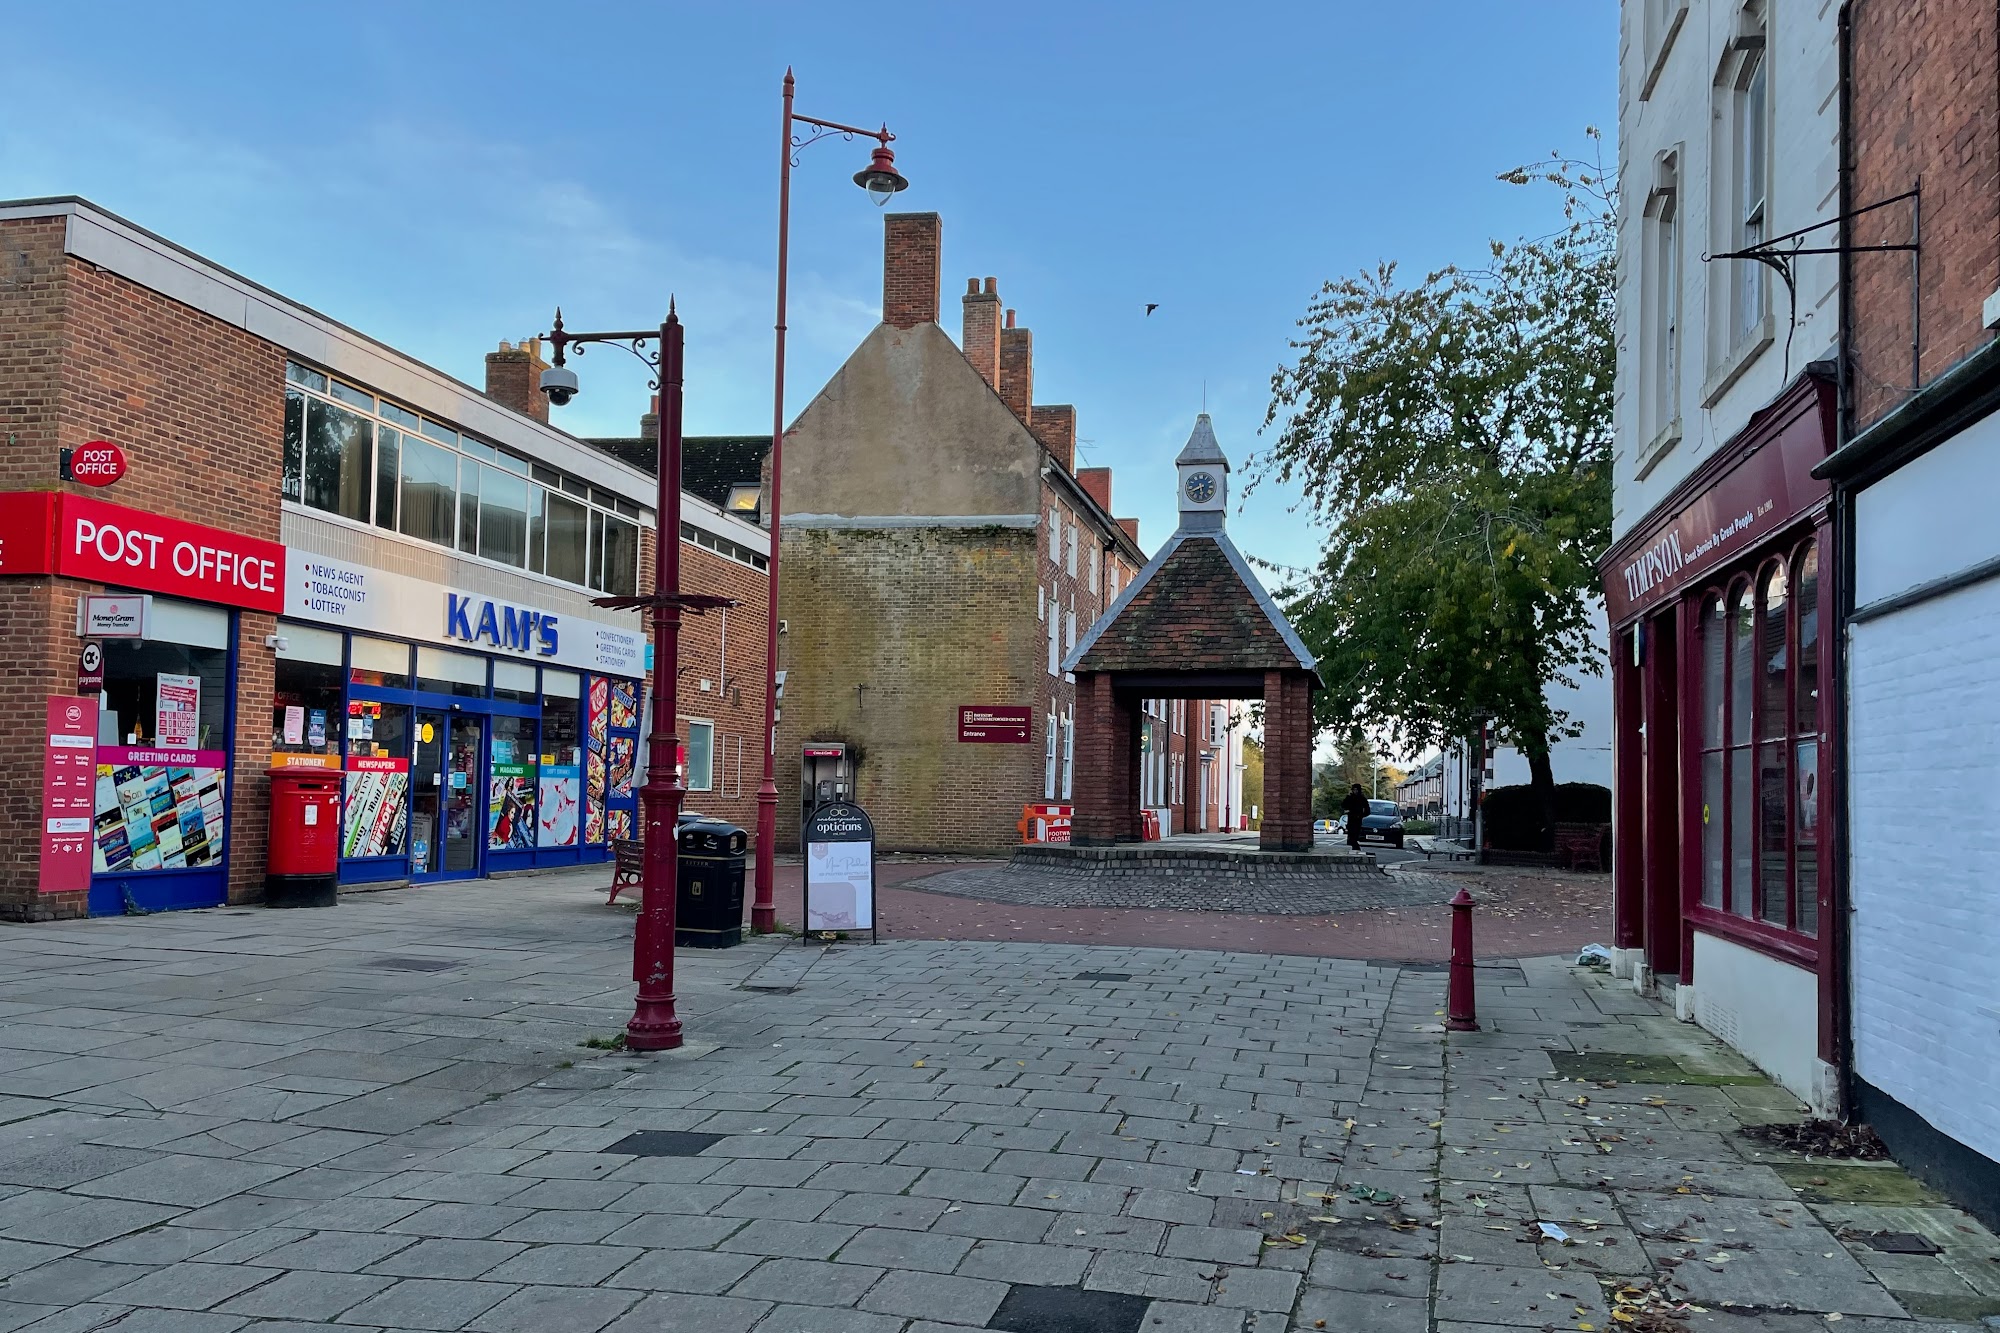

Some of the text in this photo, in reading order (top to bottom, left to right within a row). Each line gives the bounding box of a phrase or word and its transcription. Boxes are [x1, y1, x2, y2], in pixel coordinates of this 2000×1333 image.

[83, 450, 114, 462] POST
[75, 463, 117, 475] OFFICE
[75, 518, 275, 593] POST OFFICE
[1624, 510, 1754, 602] TIMPSON Great Service By Great People
[312, 564, 364, 587] NEWS AGENT
[312, 581, 366, 603] TOBACCONIST
[311, 598, 346, 616] LOTTERY
[92, 614, 134, 623] MoneyGram
[442, 592, 559, 657] KAM'S
[600, 630, 634, 646] CONFECTIONERY
[600, 643, 636, 659] GREETING CARDS
[600, 655, 626, 668] STATIONERY
[79, 676, 102, 686] payzone
[128, 751, 196, 763] GREETING CARDS
[286, 757, 326, 767] STATIONERY
[358, 760, 396, 770] NEWSPAPERS
[499, 766, 524, 775] MAGAZINES
[123, 790, 143, 803] Son
[817, 821, 862, 834] opticians
